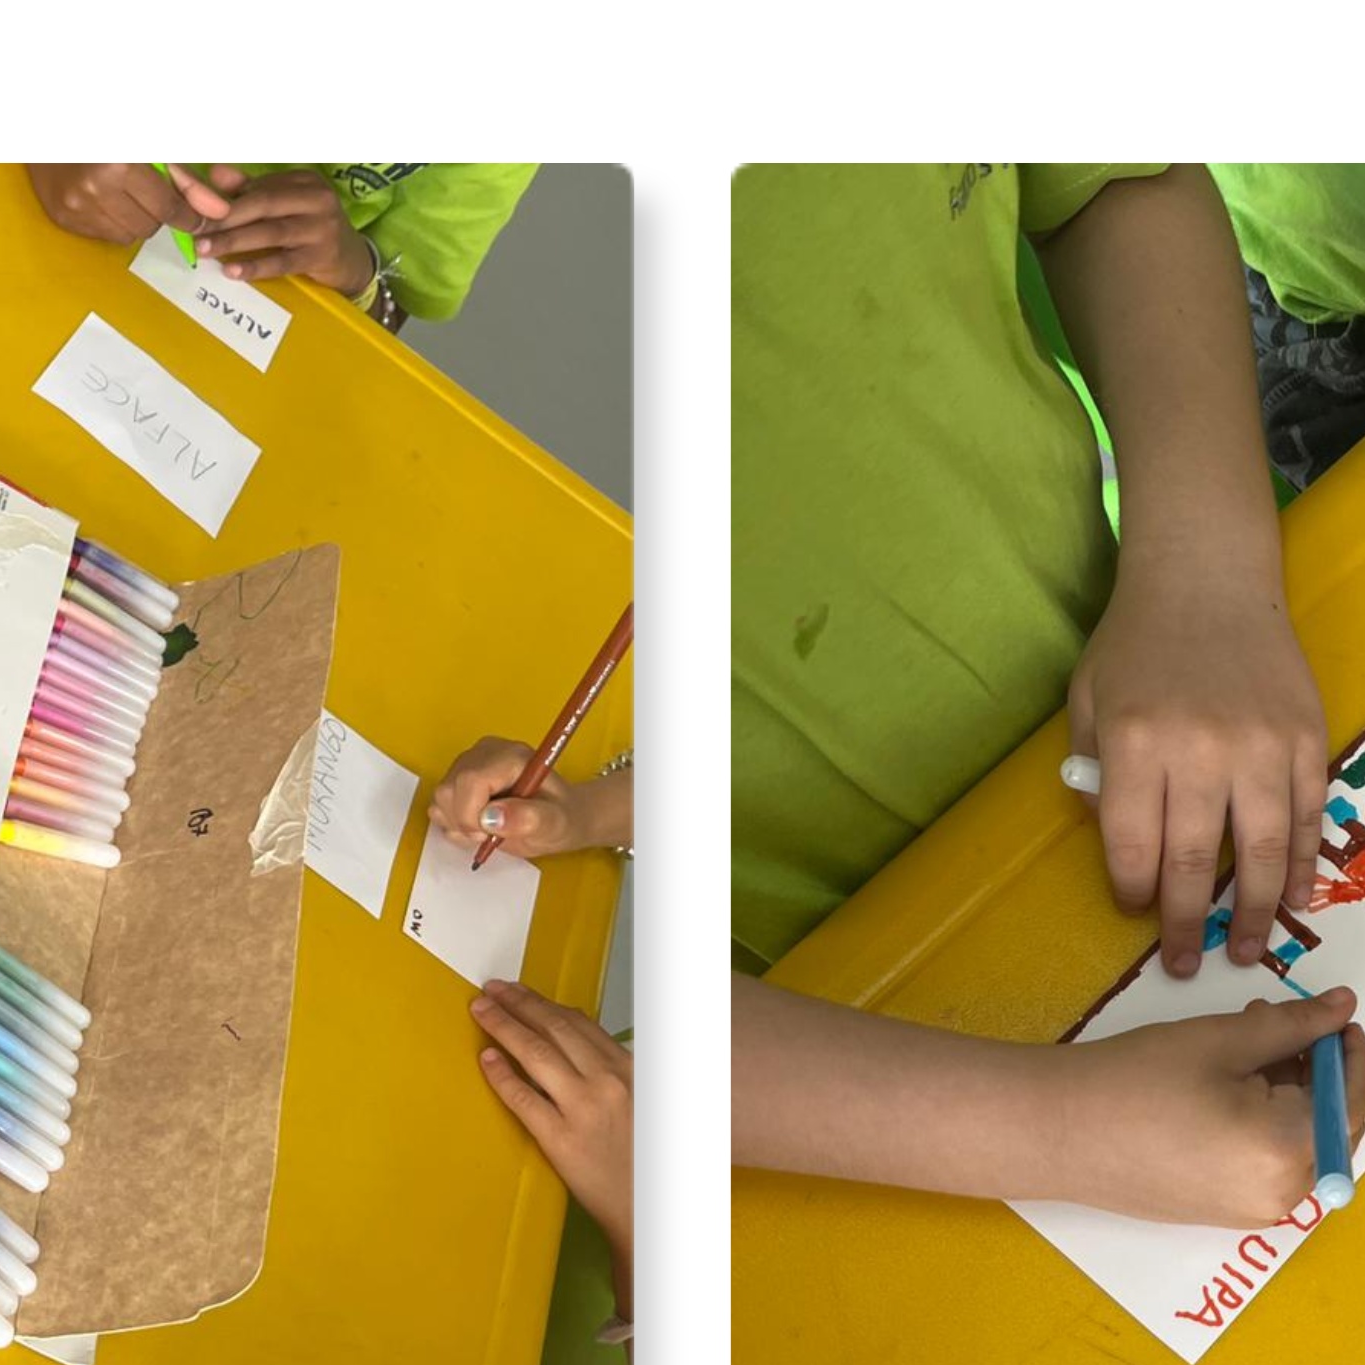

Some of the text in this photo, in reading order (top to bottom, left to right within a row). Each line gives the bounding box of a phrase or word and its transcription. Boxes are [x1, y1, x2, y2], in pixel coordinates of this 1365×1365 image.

[196, 286, 273, 341] ALFACE
[79, 363, 218, 481] ALFACE
[1174, 1192, 1324, 1328] QUIPA
